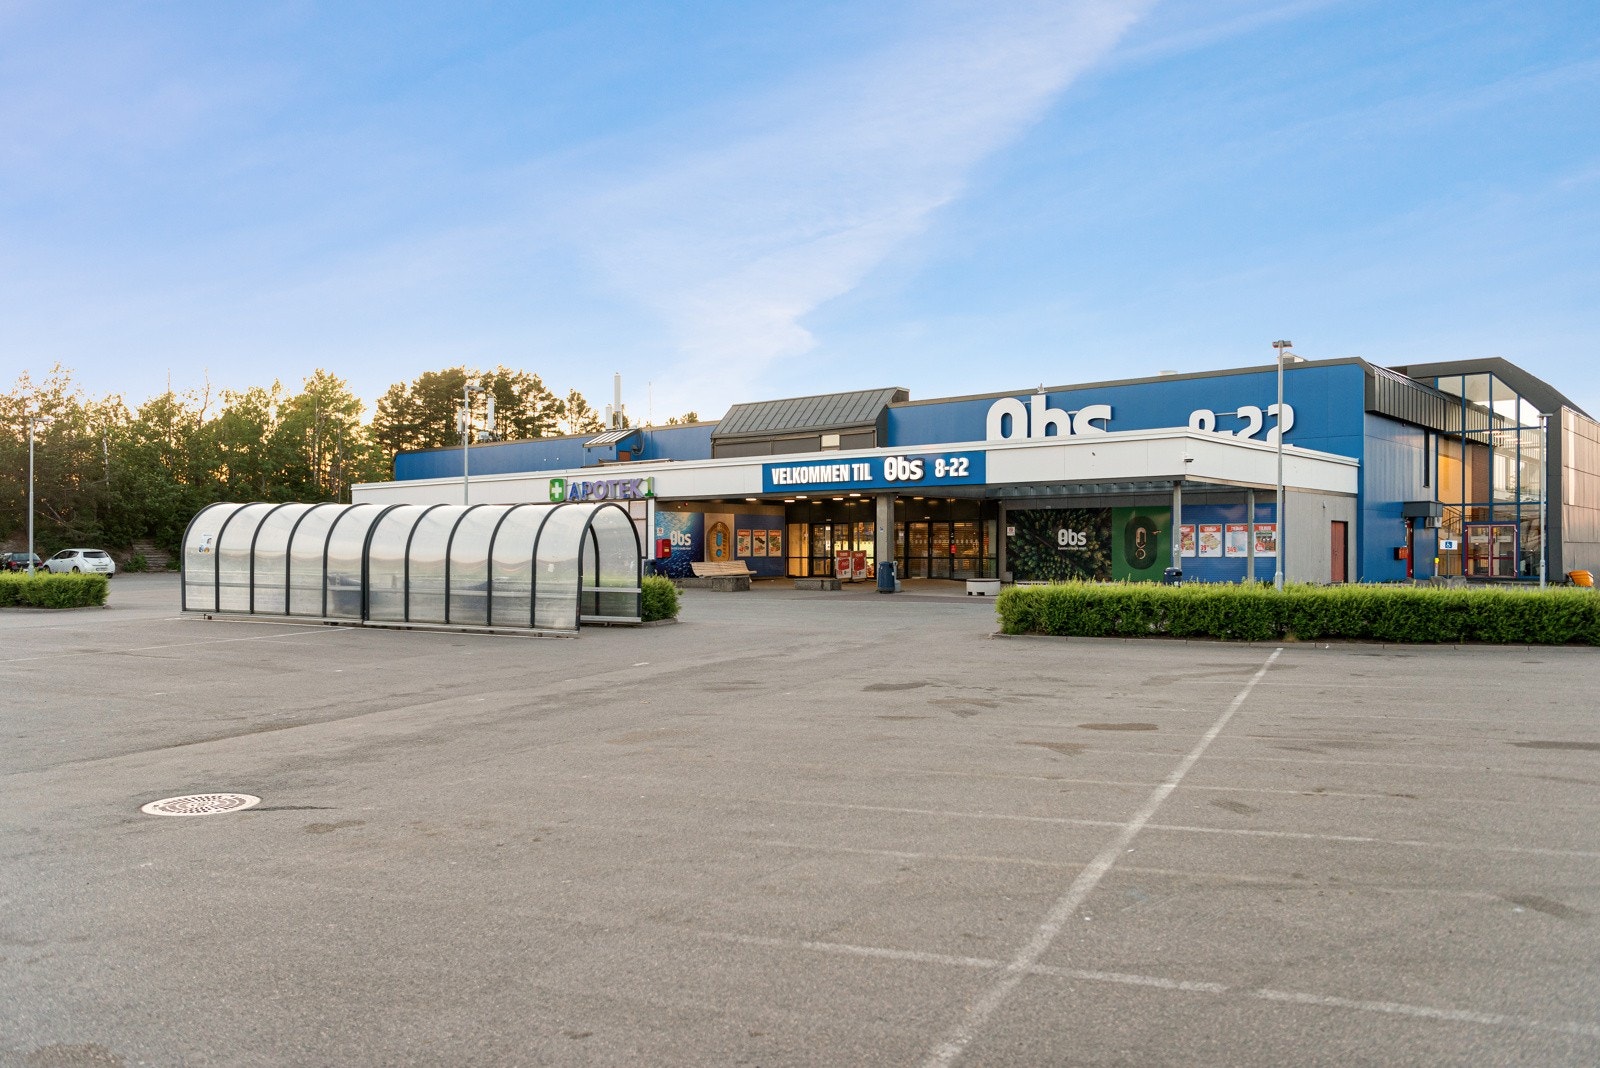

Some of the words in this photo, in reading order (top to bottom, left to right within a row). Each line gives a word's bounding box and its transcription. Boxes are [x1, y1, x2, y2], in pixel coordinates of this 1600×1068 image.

[771, 464, 850, 485] VELKOMMEN
[851, 463, 873, 481] TIL
[884, 456, 924, 481] Obs
[935, 457, 969, 478] 8-22
[670, 530, 692, 546] Obs
[1057, 528, 1087, 546] Obs
